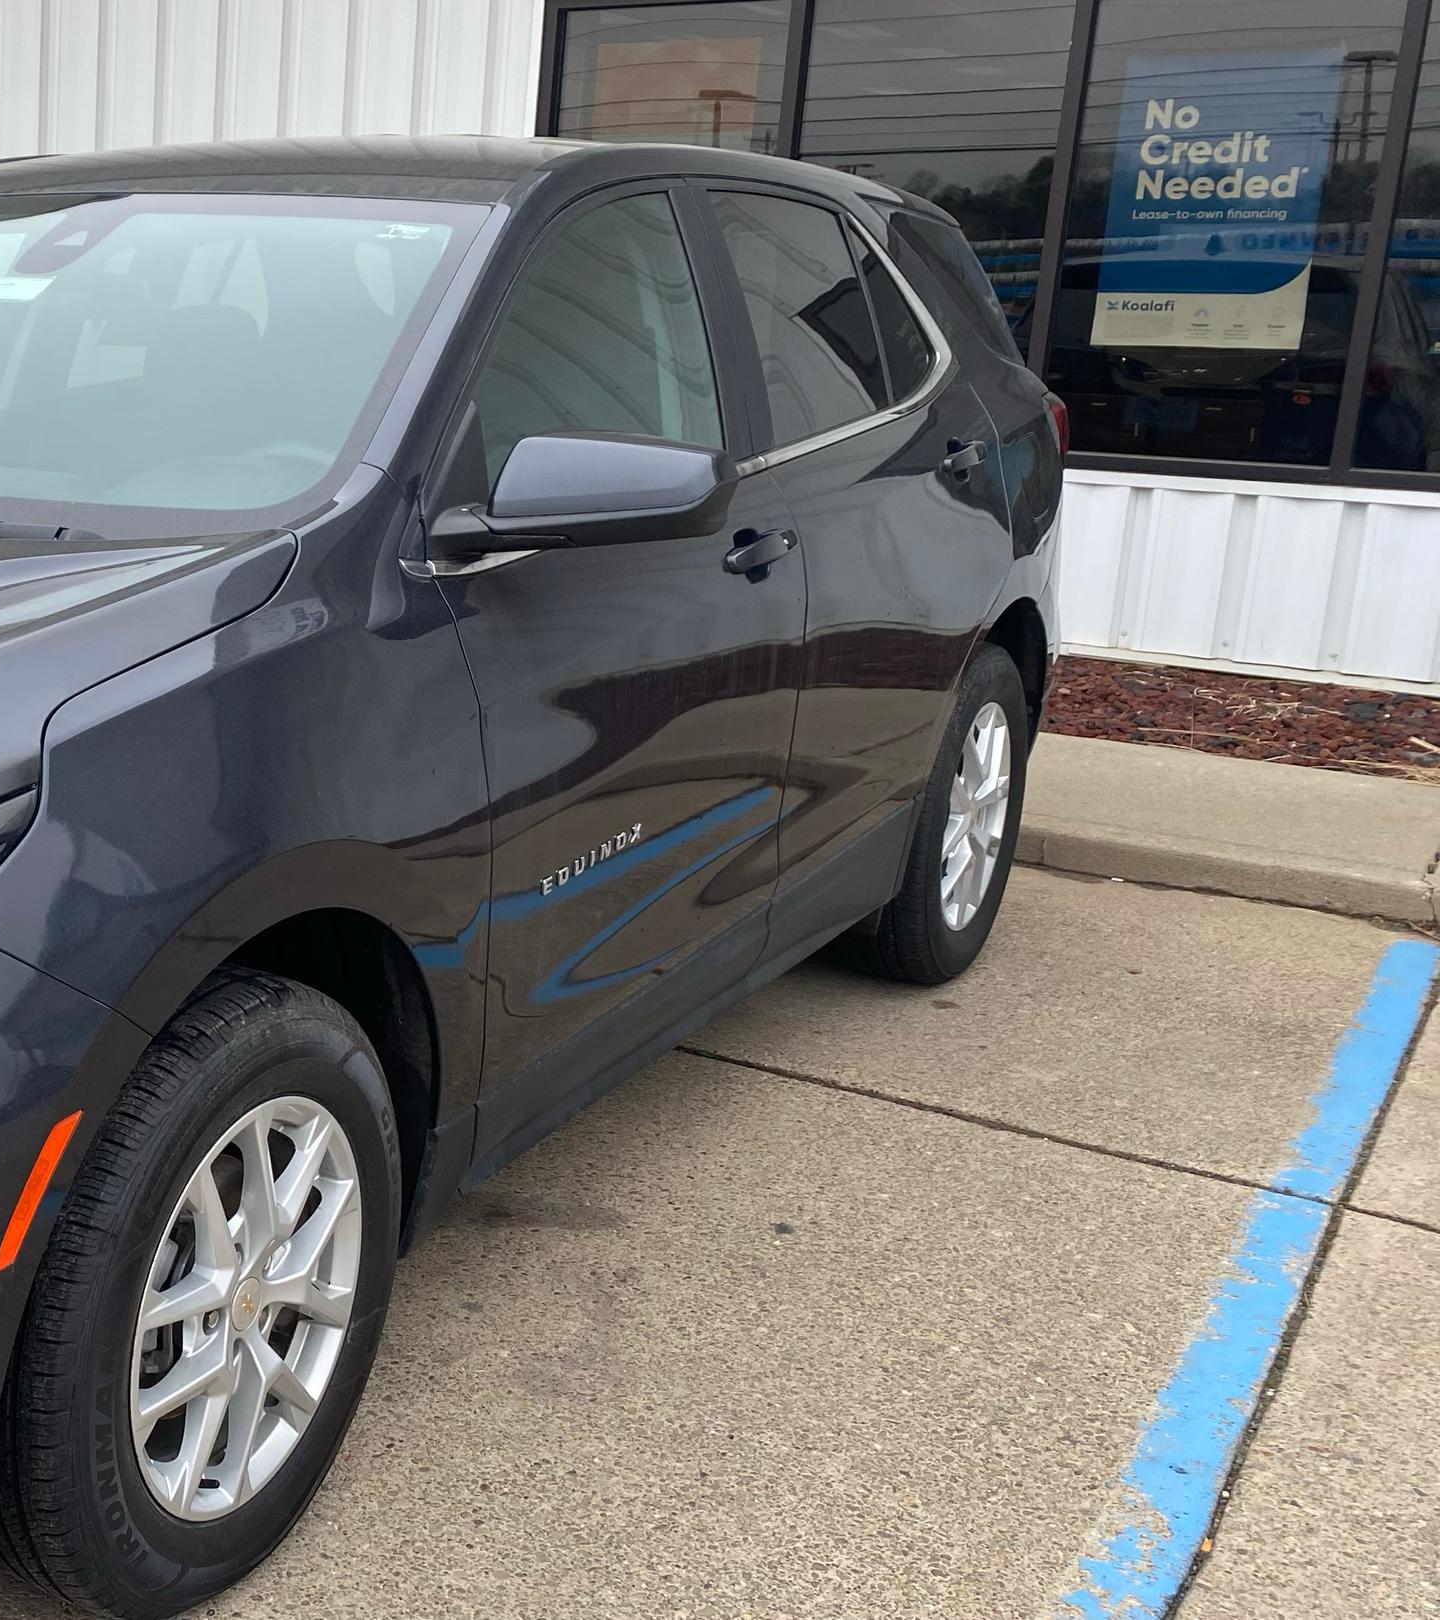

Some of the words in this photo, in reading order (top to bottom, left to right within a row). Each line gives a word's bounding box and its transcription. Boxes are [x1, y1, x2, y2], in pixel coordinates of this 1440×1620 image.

[1144, 98, 1201, 130] No
[1140, 130, 1271, 165] Credit
[1132, 209, 1223, 220] Lease-to-own
[1227, 208, 1288, 221] financing
[1121, 300, 1176, 312] Koalafi
[540, 822, 642, 896] EQUINOX
